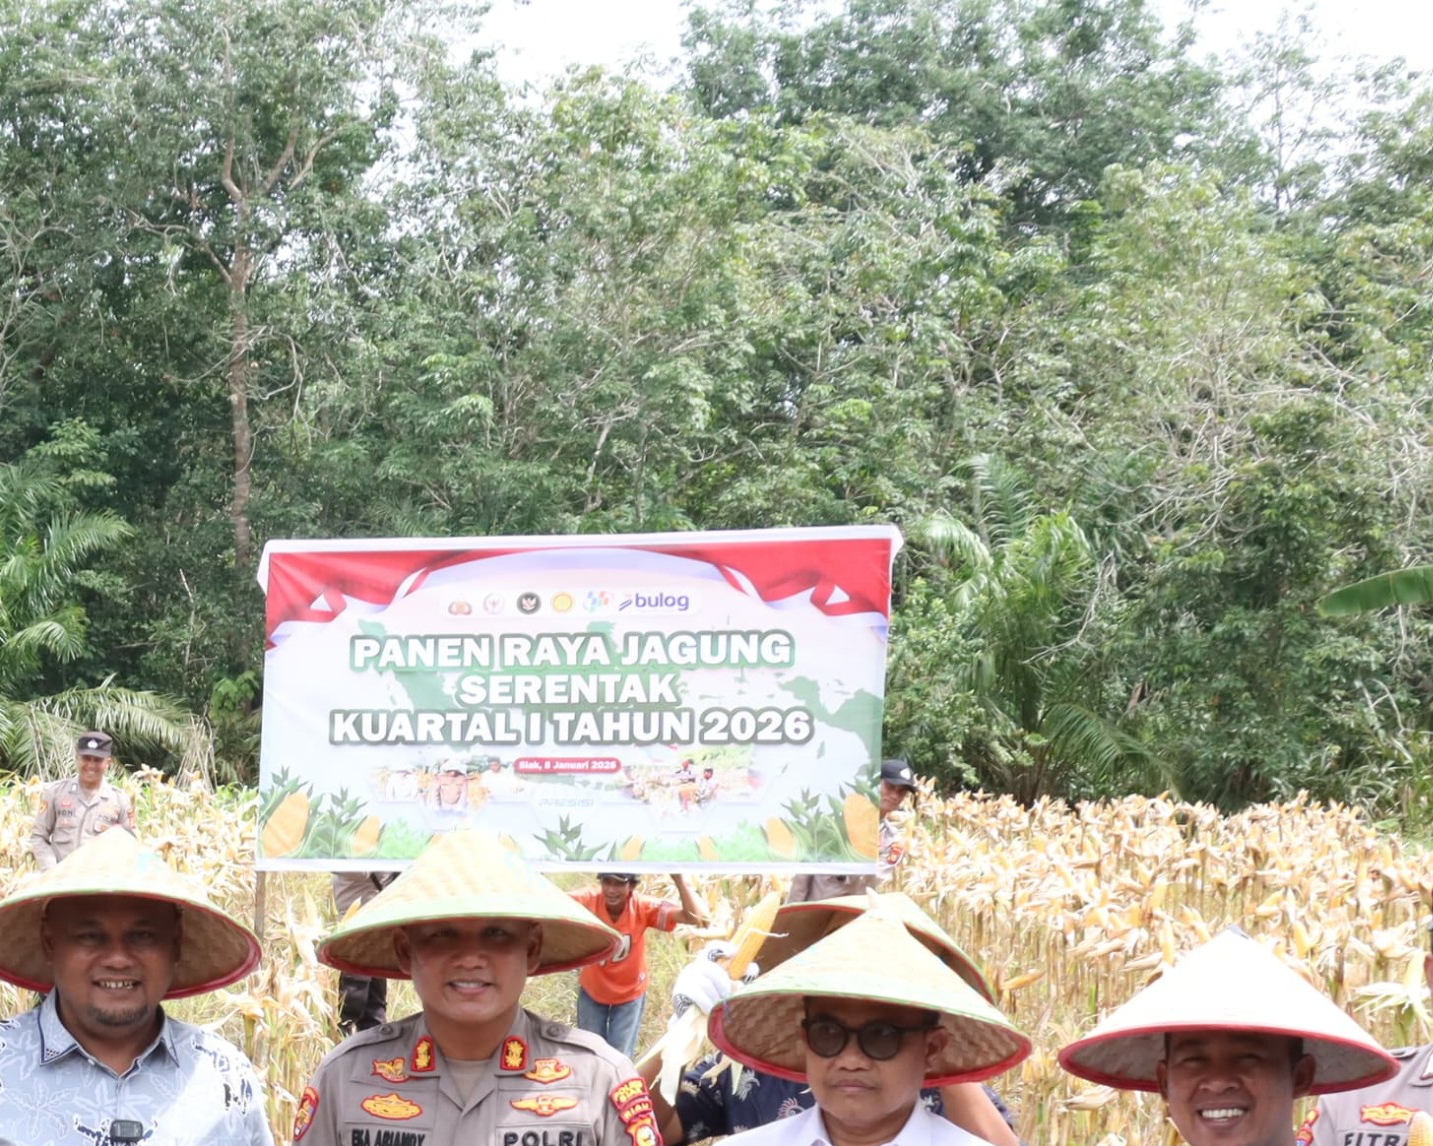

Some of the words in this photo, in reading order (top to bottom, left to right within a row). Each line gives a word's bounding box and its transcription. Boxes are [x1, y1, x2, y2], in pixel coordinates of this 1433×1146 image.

[634, 593, 690, 611] bulog
[352, 636, 492, 669] PANEN
[502, 635, 612, 667] RAYA
[620, 632, 792, 666] JAGUNG
[457, 672, 678, 706] SERENTAK
[332, 710, 518, 743] KUARTAL
[529, 710, 542, 743] I
[550, 709, 691, 743] TAHUN
[702, 708, 812, 743] 2026
[553, 760, 589, 770] Januari
